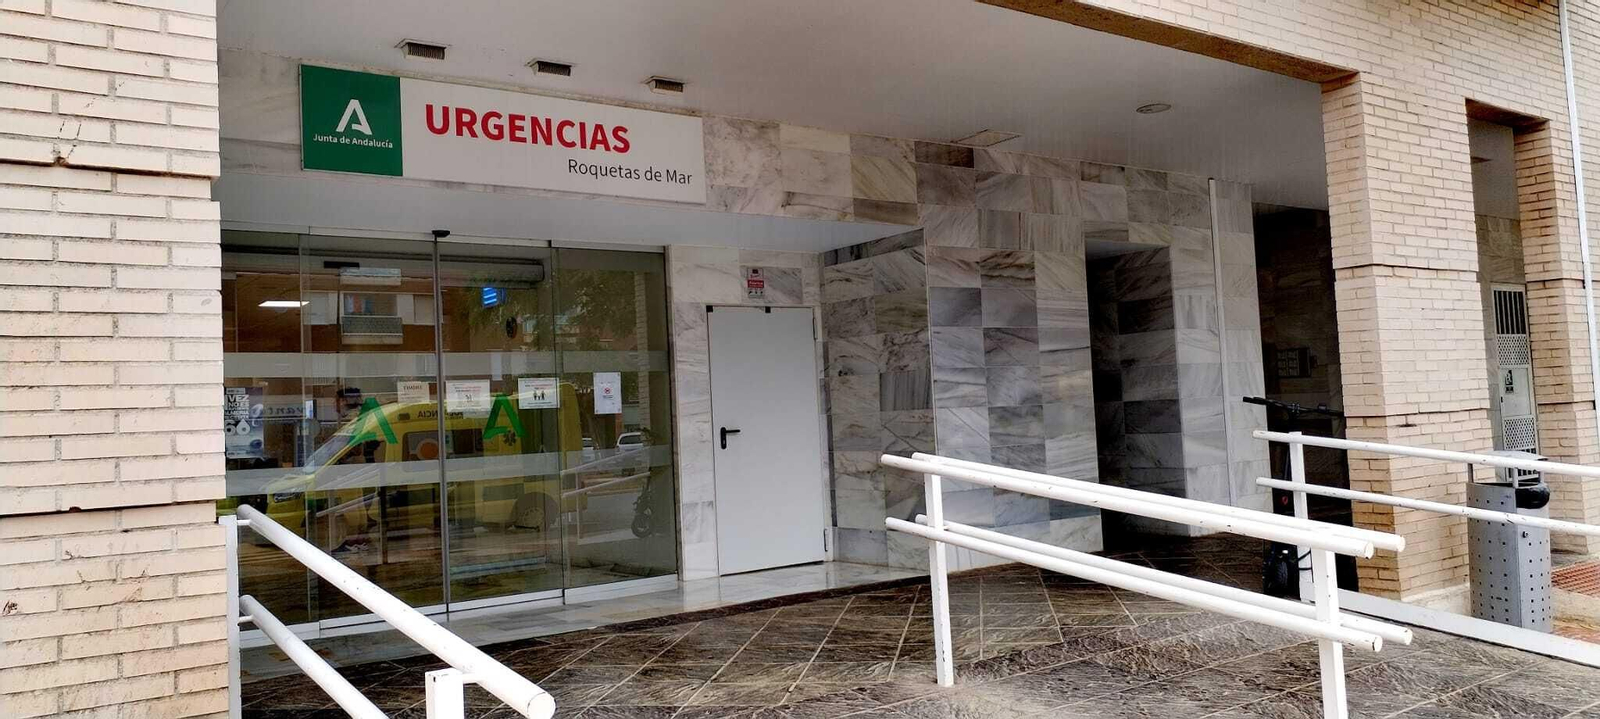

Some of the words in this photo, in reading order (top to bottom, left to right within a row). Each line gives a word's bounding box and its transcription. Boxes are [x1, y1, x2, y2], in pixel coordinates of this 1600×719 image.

[312, 133, 338, 143] Junta
[339, 135, 351, 145] de
[351, 137, 394, 149] Andalucía
[425, 103, 631, 154] URGENCIAS
[568, 158, 641, 180] Roquetas
[644, 165, 662, 182] de
[666, 169, 693, 184] Mar
